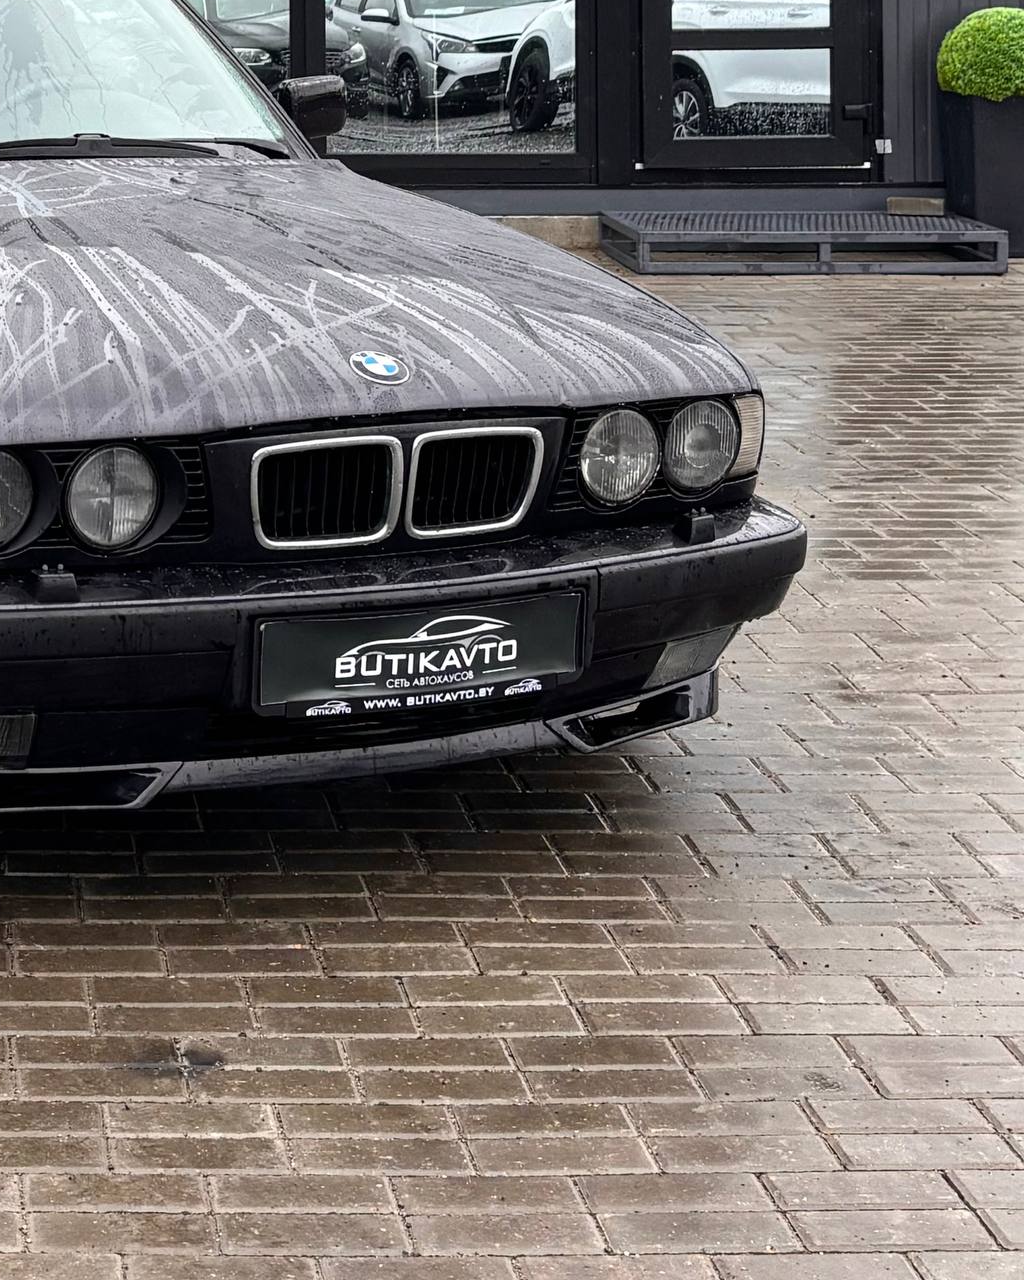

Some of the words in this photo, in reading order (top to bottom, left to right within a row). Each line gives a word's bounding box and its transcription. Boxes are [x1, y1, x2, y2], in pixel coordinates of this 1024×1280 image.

[335, 639, 517, 678] BUTIKAVTO
[386, 677, 410, 689] СЕТЬ
[412, 671, 474, 686] АВТОХАУСОВ
[406, 686, 495, 706] BUTIKAVTO.BY
[306, 707, 352, 717] BUTIKAVTO
